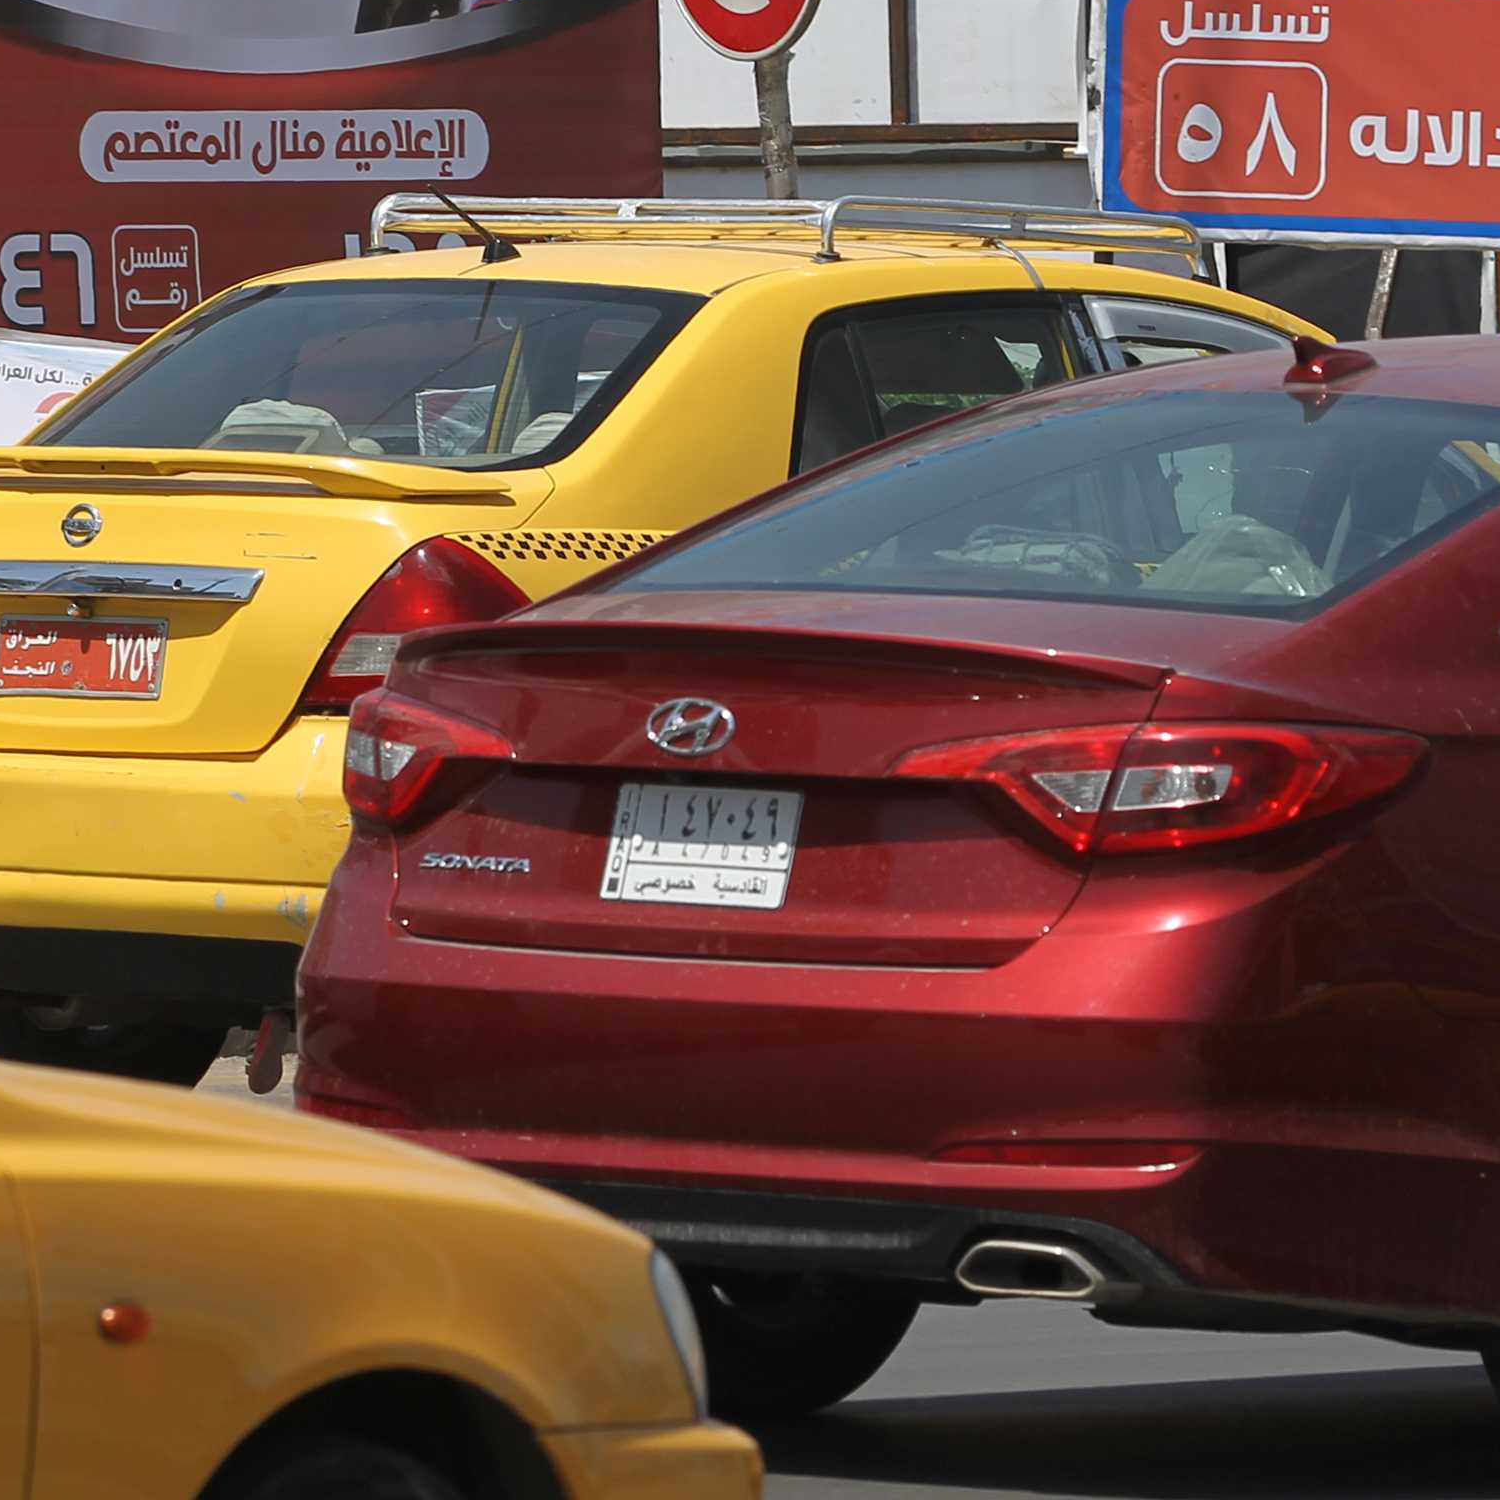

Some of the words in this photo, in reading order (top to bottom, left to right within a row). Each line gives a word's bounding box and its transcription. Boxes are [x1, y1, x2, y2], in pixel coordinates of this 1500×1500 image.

[1157, 0, 1331, 47] تسلسل
[102, 119, 242, 173] المعتصم
[251, 118, 325, 175] منال
[334, 118, 467, 178] الإعلامية
[1175, 89, 1299, 179] ٥٨
[0, 232, 97, 326] ٤٦
[119, 245, 189, 275] تسلسل
[124, 281, 189, 313] رقم
[35, 368, 63, 384] لكل
[1, 658, 56, 678] النجف
[5, 628, 59, 650] العراق
[105, 631, 163, 683] ٦٧٥٣
[419, 851, 531, 873] SONATA
